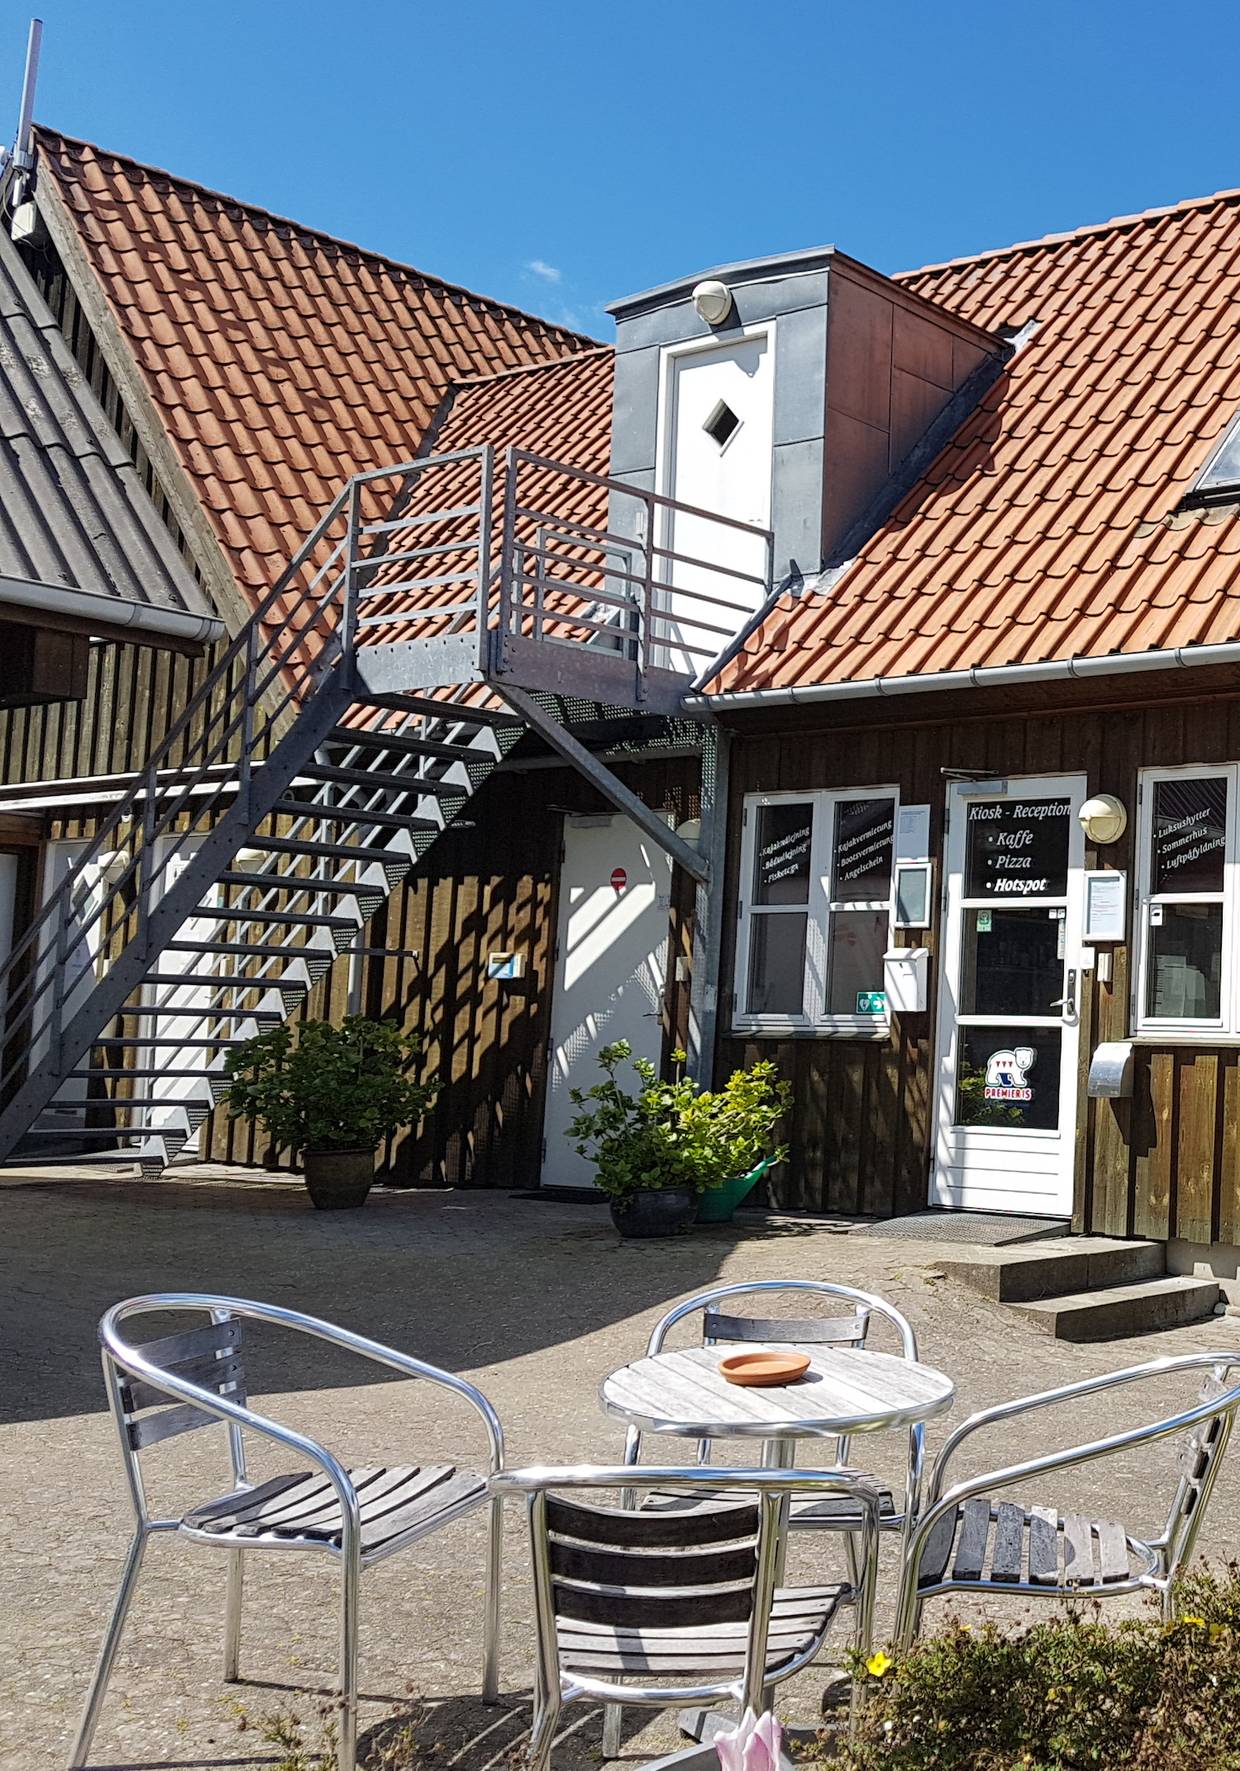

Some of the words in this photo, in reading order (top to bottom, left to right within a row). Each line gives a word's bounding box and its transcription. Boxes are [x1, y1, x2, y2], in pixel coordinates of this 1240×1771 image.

[969, 804, 1003, 820] Kiosk
[1012, 801, 1071, 820] Reception
[1158, 807, 1211, 839] Luksushytter
[996, 829, 1034, 849] Kaffe
[1162, 827, 1208, 854] Sommerhus
[843, 856, 884, 881] Angelschein
[995, 855, 1032, 869] Pizza
[994, 878, 1047, 895] Hotspot
